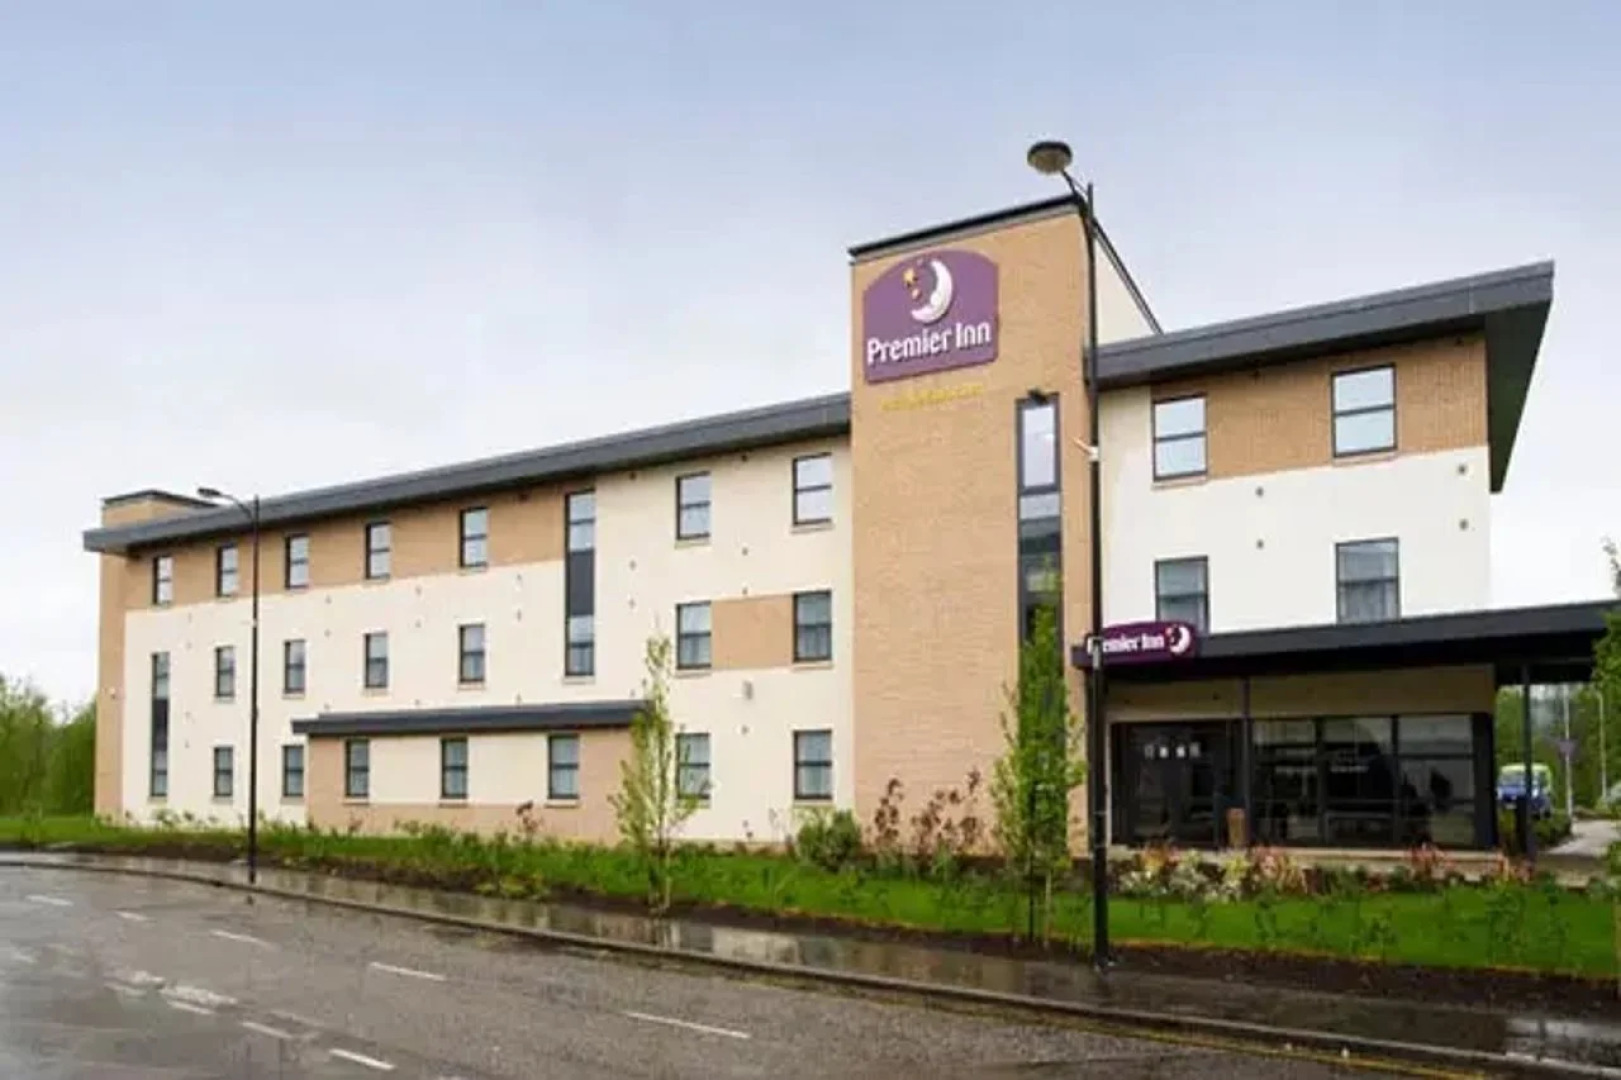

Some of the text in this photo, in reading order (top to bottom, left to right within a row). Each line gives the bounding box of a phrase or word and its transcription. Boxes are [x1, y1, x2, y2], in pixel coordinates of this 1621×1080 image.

[867, 322, 991, 365] Premier Inn
[1087, 633, 1165, 654] emier Inn
